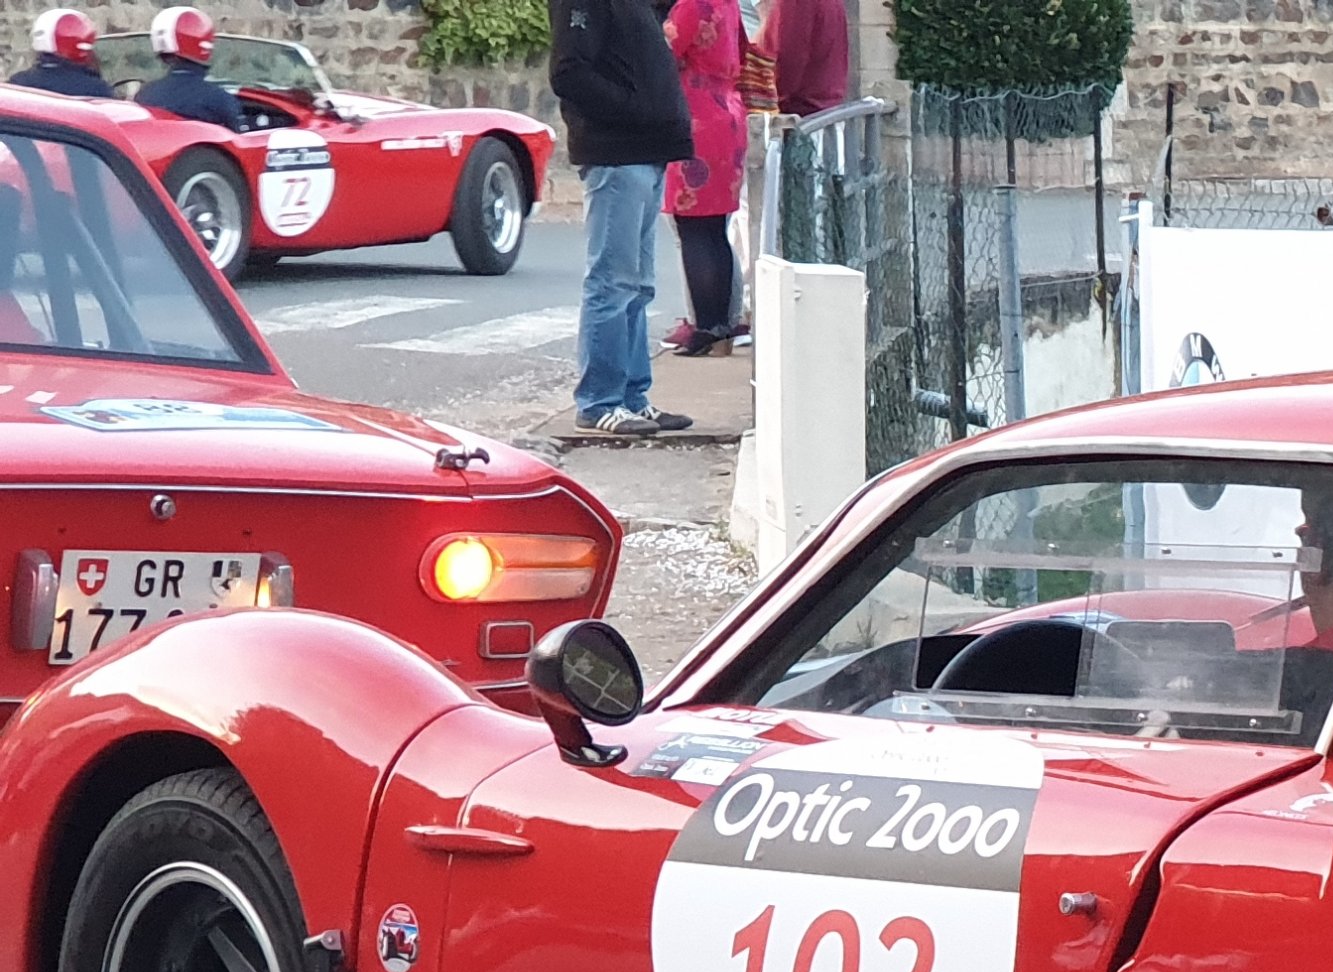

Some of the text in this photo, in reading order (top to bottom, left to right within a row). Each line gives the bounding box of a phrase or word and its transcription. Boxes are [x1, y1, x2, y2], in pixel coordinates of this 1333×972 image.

[279, 176, 312, 208] 72
[134, 559, 185, 598] GR
[53, 607, 184, 661] 177
[713, 772, 1020, 861] Optic 2000
